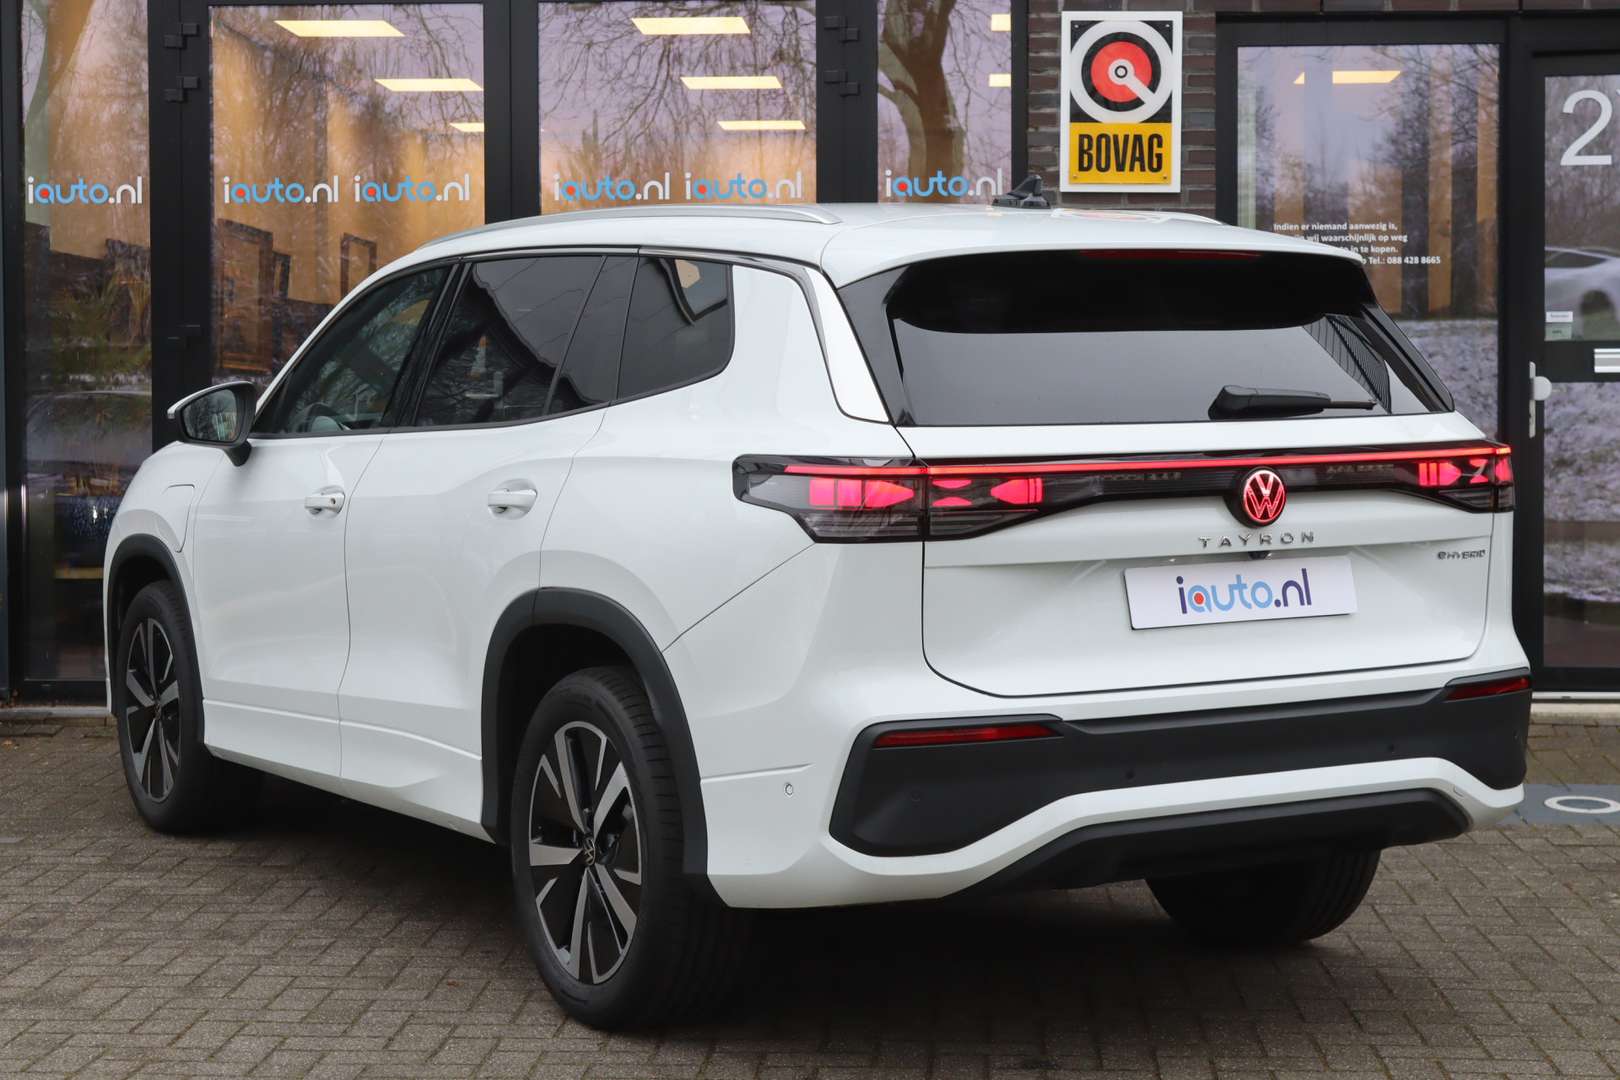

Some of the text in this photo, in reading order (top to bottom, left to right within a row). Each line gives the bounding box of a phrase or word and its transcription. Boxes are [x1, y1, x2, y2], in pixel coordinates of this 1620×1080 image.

[1078, 133, 1164, 174] BOVAG
[27, 176, 143, 204] iauto.nl
[223, 175, 339, 204] iauto.nl
[354, 174, 471, 203] iauto.nl
[554, 172, 671, 201] iauto.nl
[685, 171, 802, 200] iauto.nl
[885, 169, 1003, 199] iauto.nl
[1273, 223, 1299, 231] Indien
[1311, 222, 1347, 231] niemand
[1349, 222, 1387, 232] aanwezig
[1321, 232, 1376, 243] waarschijnlijk
[1378, 234, 1389, 243] op
[1391, 234, 1408, 243] weg
[1360, 245, 1369, 253] te
[1370, 244, 1398, 254] kopen.
[1387, 256, 1402, 264] 088
[1404, 256, 1418, 264] 428
[1421, 255, 1441, 264] 8665
[1198, 531, 1315, 549] TAYRON
[1176, 568, 1312, 614] iauto.nl
